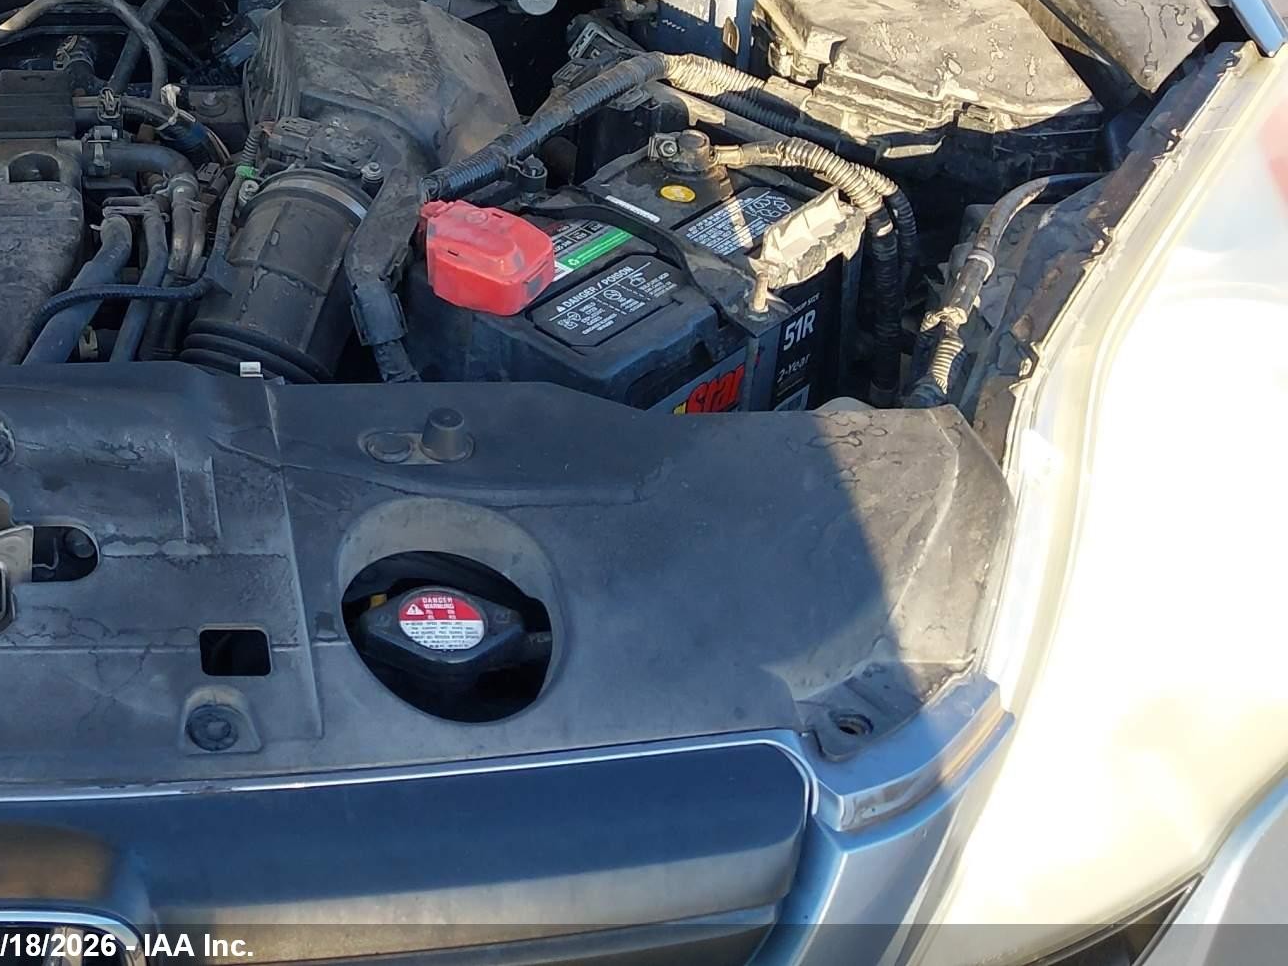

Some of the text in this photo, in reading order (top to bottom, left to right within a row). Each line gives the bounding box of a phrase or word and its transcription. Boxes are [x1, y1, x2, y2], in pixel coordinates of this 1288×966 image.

[561, 285, 599, 308] DANGER
[601, 266, 634, 286] POISON
[783, 309, 816, 351] 51R
[777, 353, 810, 383] 2-Year
